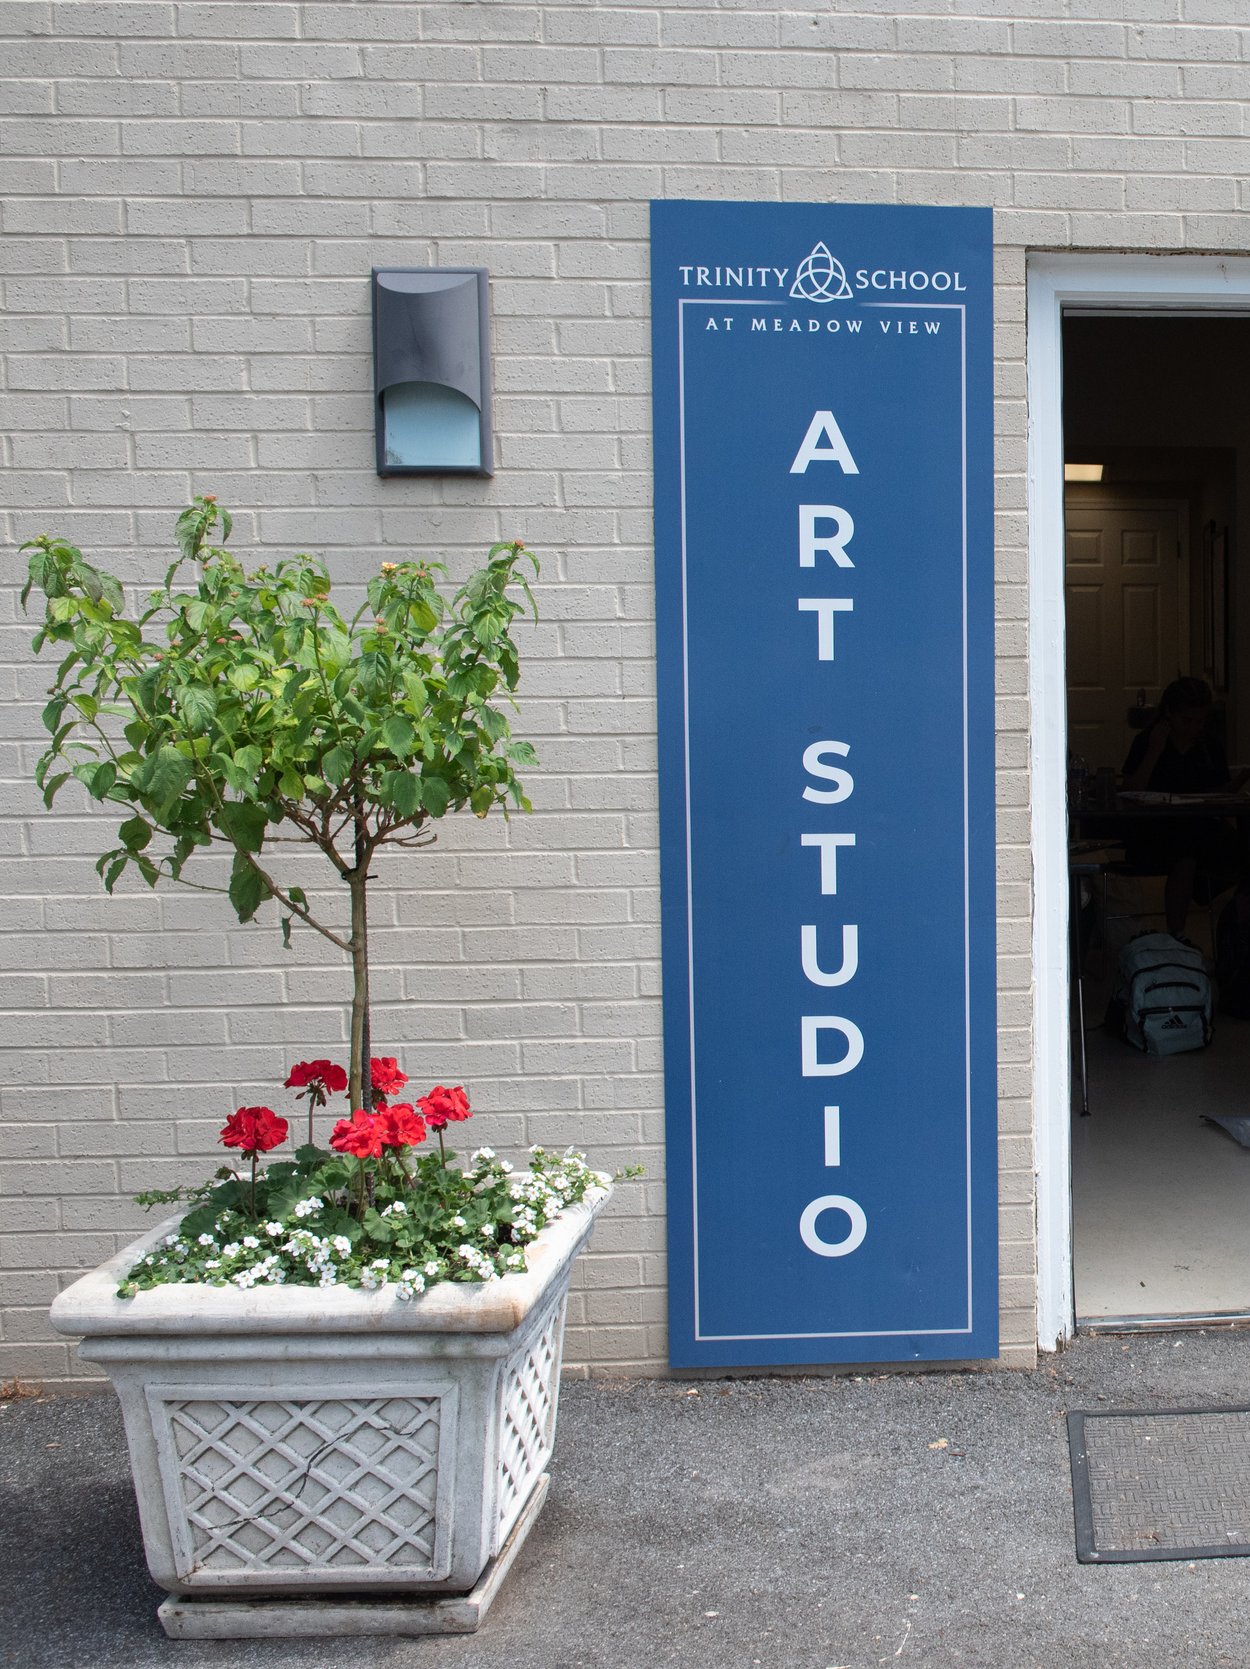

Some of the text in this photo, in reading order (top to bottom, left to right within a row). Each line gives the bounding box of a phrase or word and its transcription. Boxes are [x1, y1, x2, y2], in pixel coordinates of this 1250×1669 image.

[678, 265, 968, 292] TRINITY SCHOOL
[705, 317, 942, 335] AT MEADOW VIEW
[789, 410, 868, 1258] ART STUDIO
